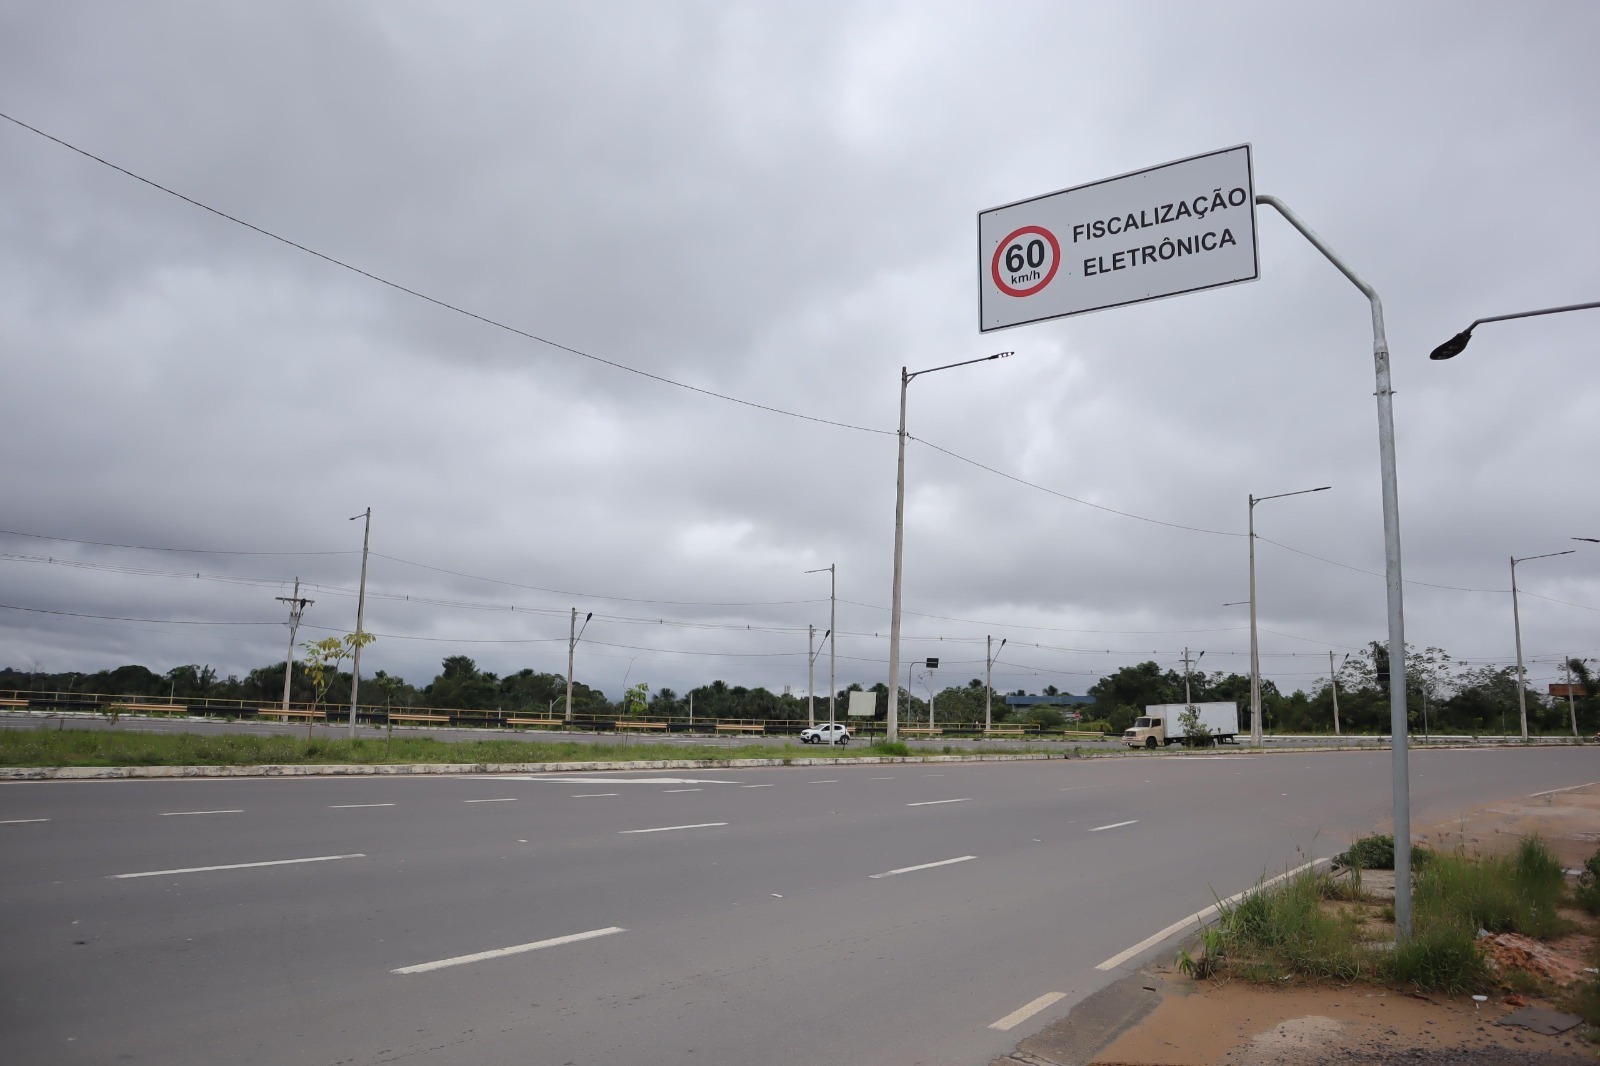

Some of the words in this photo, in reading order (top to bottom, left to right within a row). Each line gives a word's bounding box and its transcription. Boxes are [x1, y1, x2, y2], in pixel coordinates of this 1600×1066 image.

[1073, 187, 1247, 242] FISCALIZAÇÃO
[1005, 239, 1045, 273] 60
[1084, 228, 1236, 276] ELETRÔNICA
[1011, 269, 1041, 284] km/h
